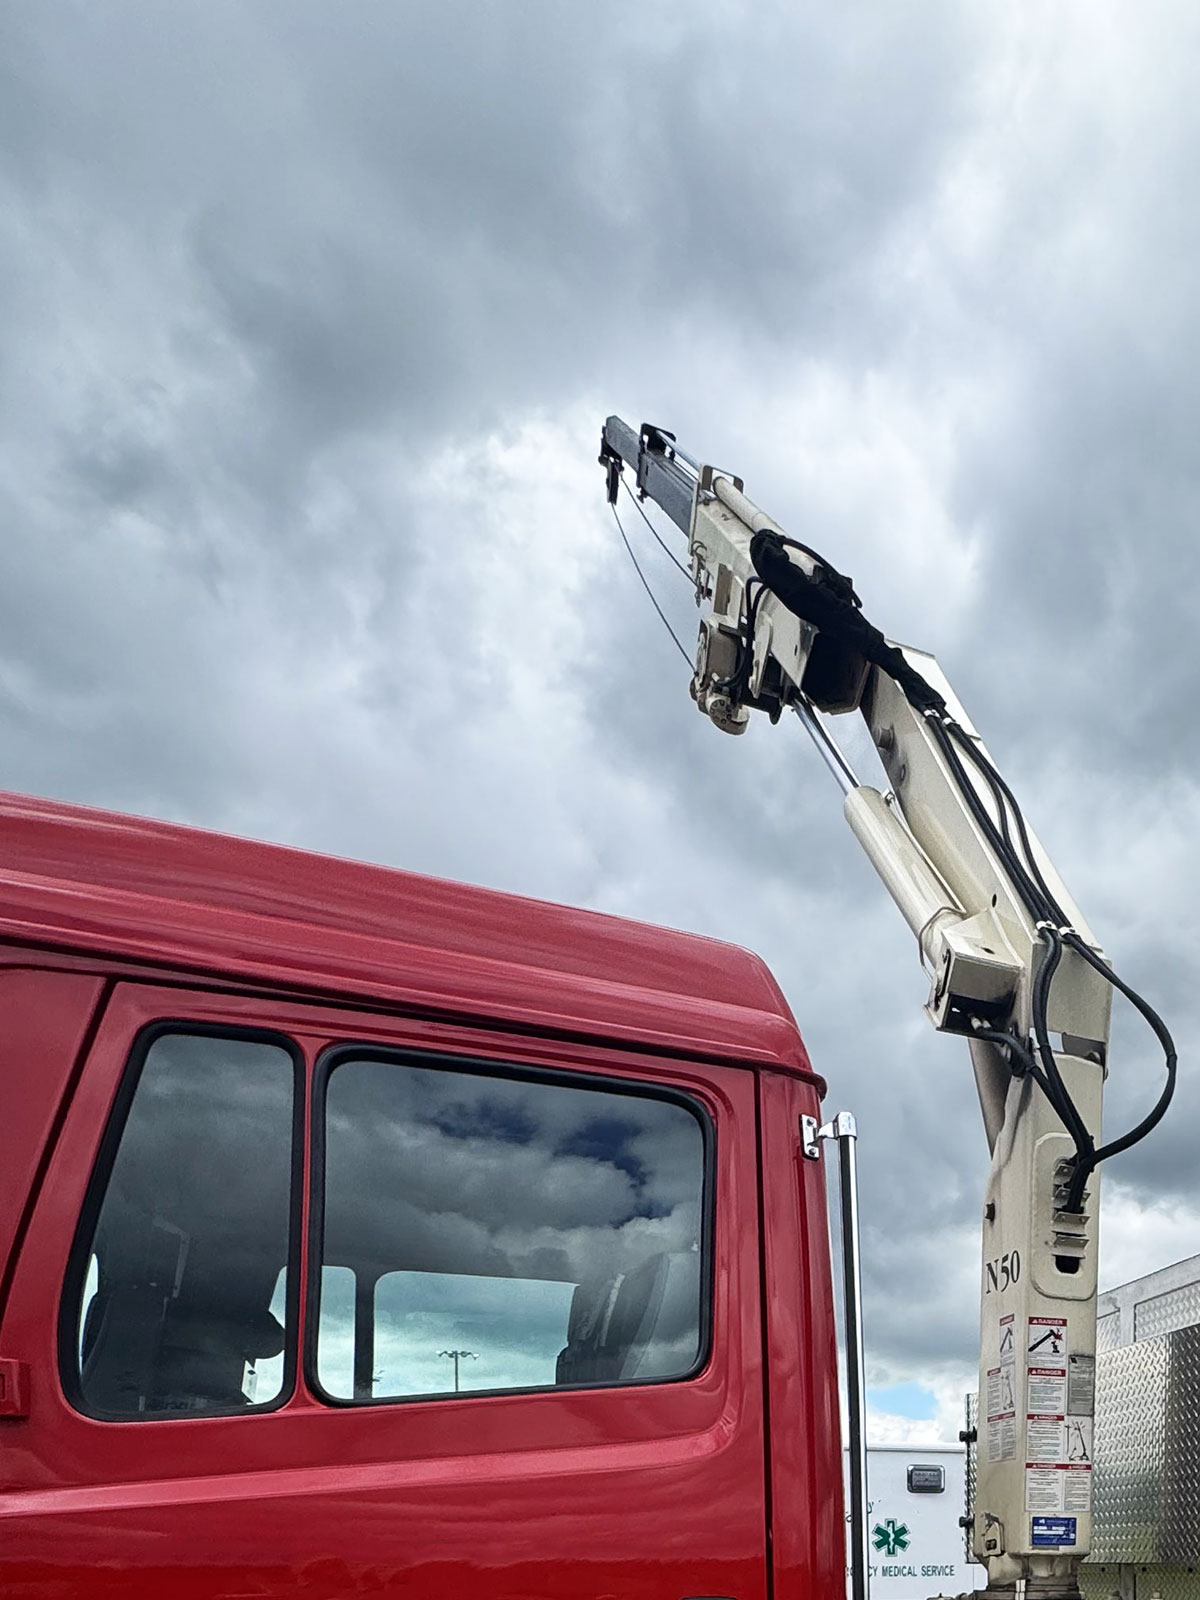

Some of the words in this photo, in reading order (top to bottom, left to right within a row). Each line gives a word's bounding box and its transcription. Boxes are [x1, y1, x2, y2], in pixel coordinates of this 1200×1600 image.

[985, 1250, 1020, 1294] N50
[882, 1565, 918, 1577] MEDICAL
[921, 1565, 955, 1577] SERVICE
